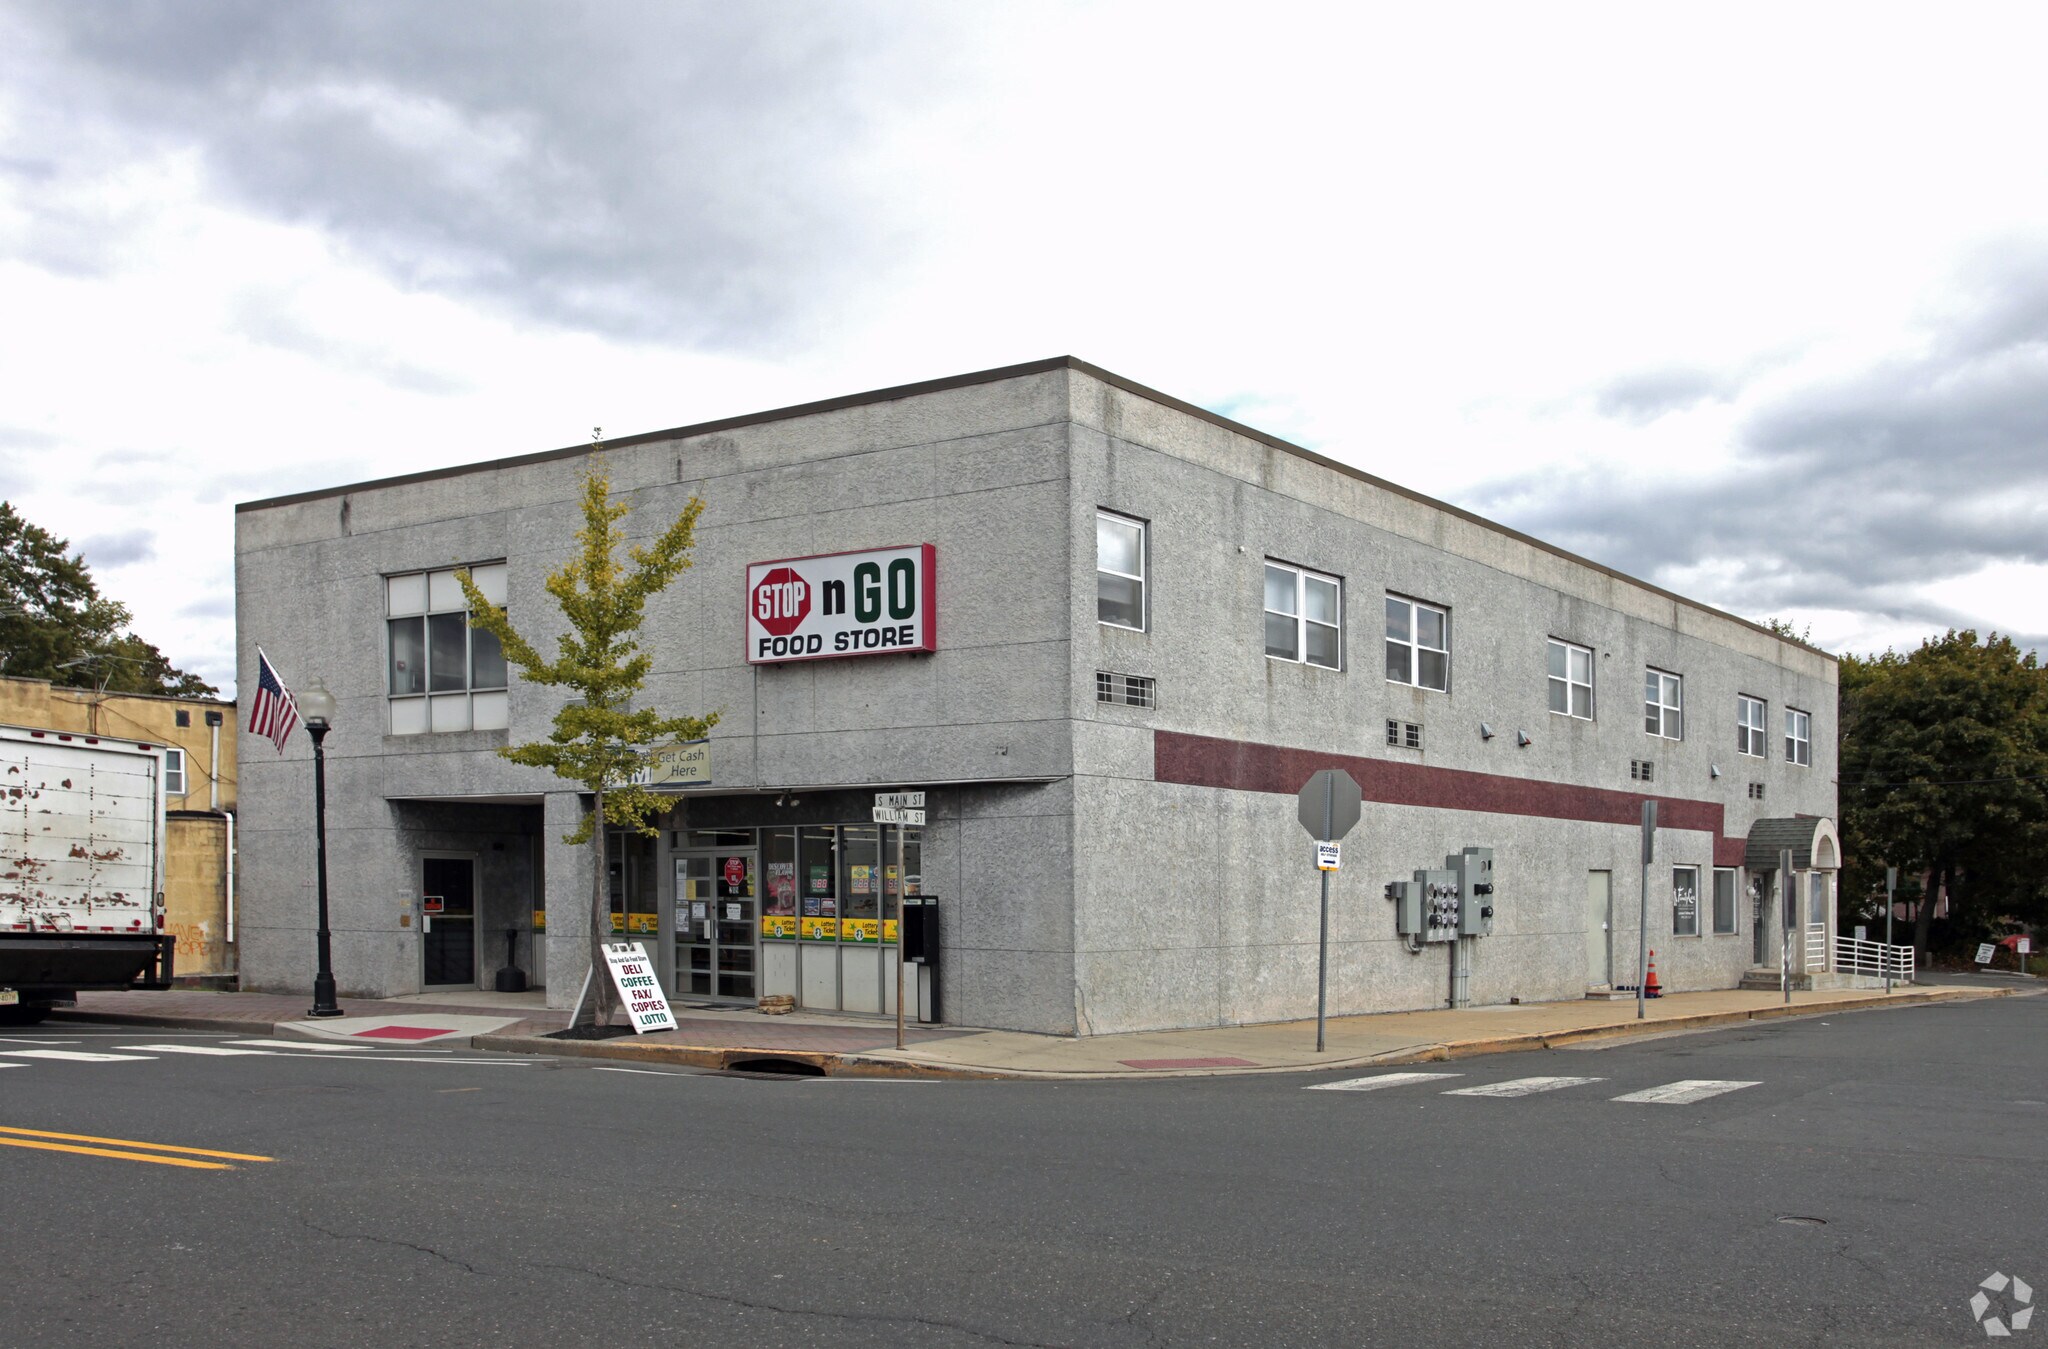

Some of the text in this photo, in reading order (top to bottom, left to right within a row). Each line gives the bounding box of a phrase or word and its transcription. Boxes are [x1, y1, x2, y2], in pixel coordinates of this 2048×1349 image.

[758, 558, 915, 623] STOP n GO
[758, 624, 914, 658] FOOD STORE
[658, 750, 676, 763] Get
[679, 748, 705, 762] Cash
[671, 765, 697, 777] Here
[878, 794, 923, 807] S MAIN ST
[874, 809, 924, 824] WILLIAM ST
[622, 964, 643, 974] DELI
[620, 976, 654, 987] COFFEE
[631, 989, 652, 999] FAX/
[631, 999, 665, 1013] COPIES
[639, 1013, 667, 1024] LOTTO
